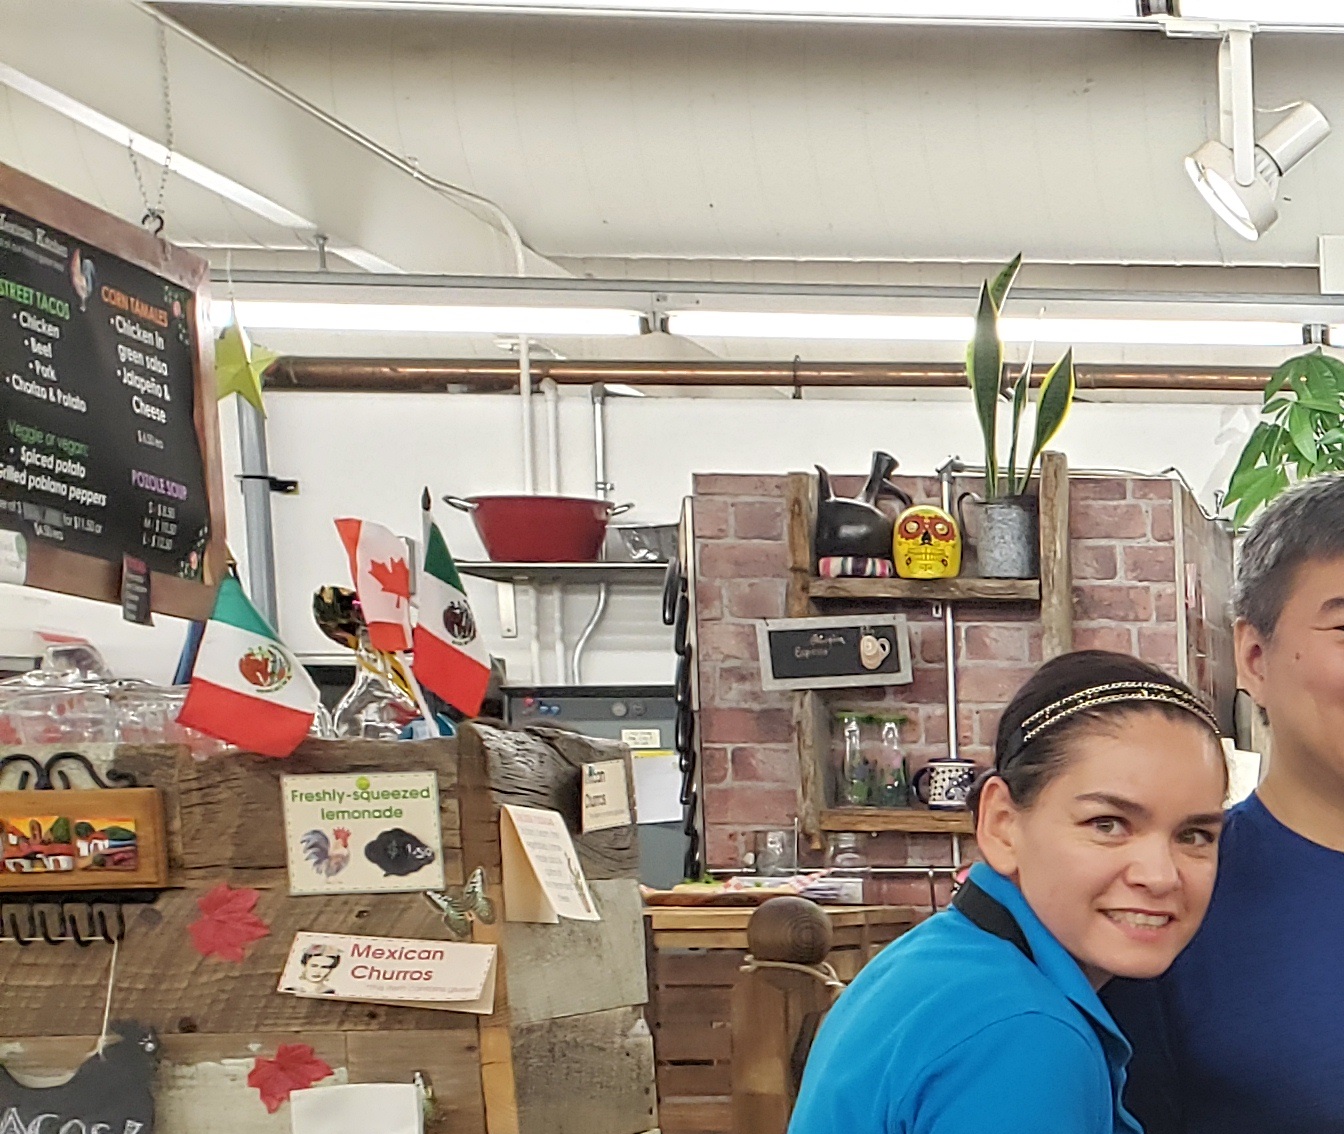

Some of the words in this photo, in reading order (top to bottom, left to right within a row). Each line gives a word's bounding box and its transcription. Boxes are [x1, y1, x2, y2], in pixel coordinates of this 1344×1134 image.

[36, 291, 70, 320] TACOS
[101, 285, 129, 310] CORN
[129, 296, 168, 327] TAMALES
[19, 311, 60, 338] Chicken
[115, 315, 155, 346] Chicken
[30, 337, 53, 358] Beef
[34, 360, 57, 381] Pork
[12, 374, 47, 400] Chorizo
[56, 388, 87, 413] Potato
[132, 395, 168, 424] Cheese
[21, 445, 55, 469] Spiced
[55, 459, 86, 479] potato
[28, 474, 68, 496] poblano
[68, 486, 107, 507] peppers
[291, 786, 431, 804] Freshly-squeezed
[320, 806, 403, 821] lemonade
[350, 943, 445, 961] Mexican
[351, 965, 434, 981] Churros
